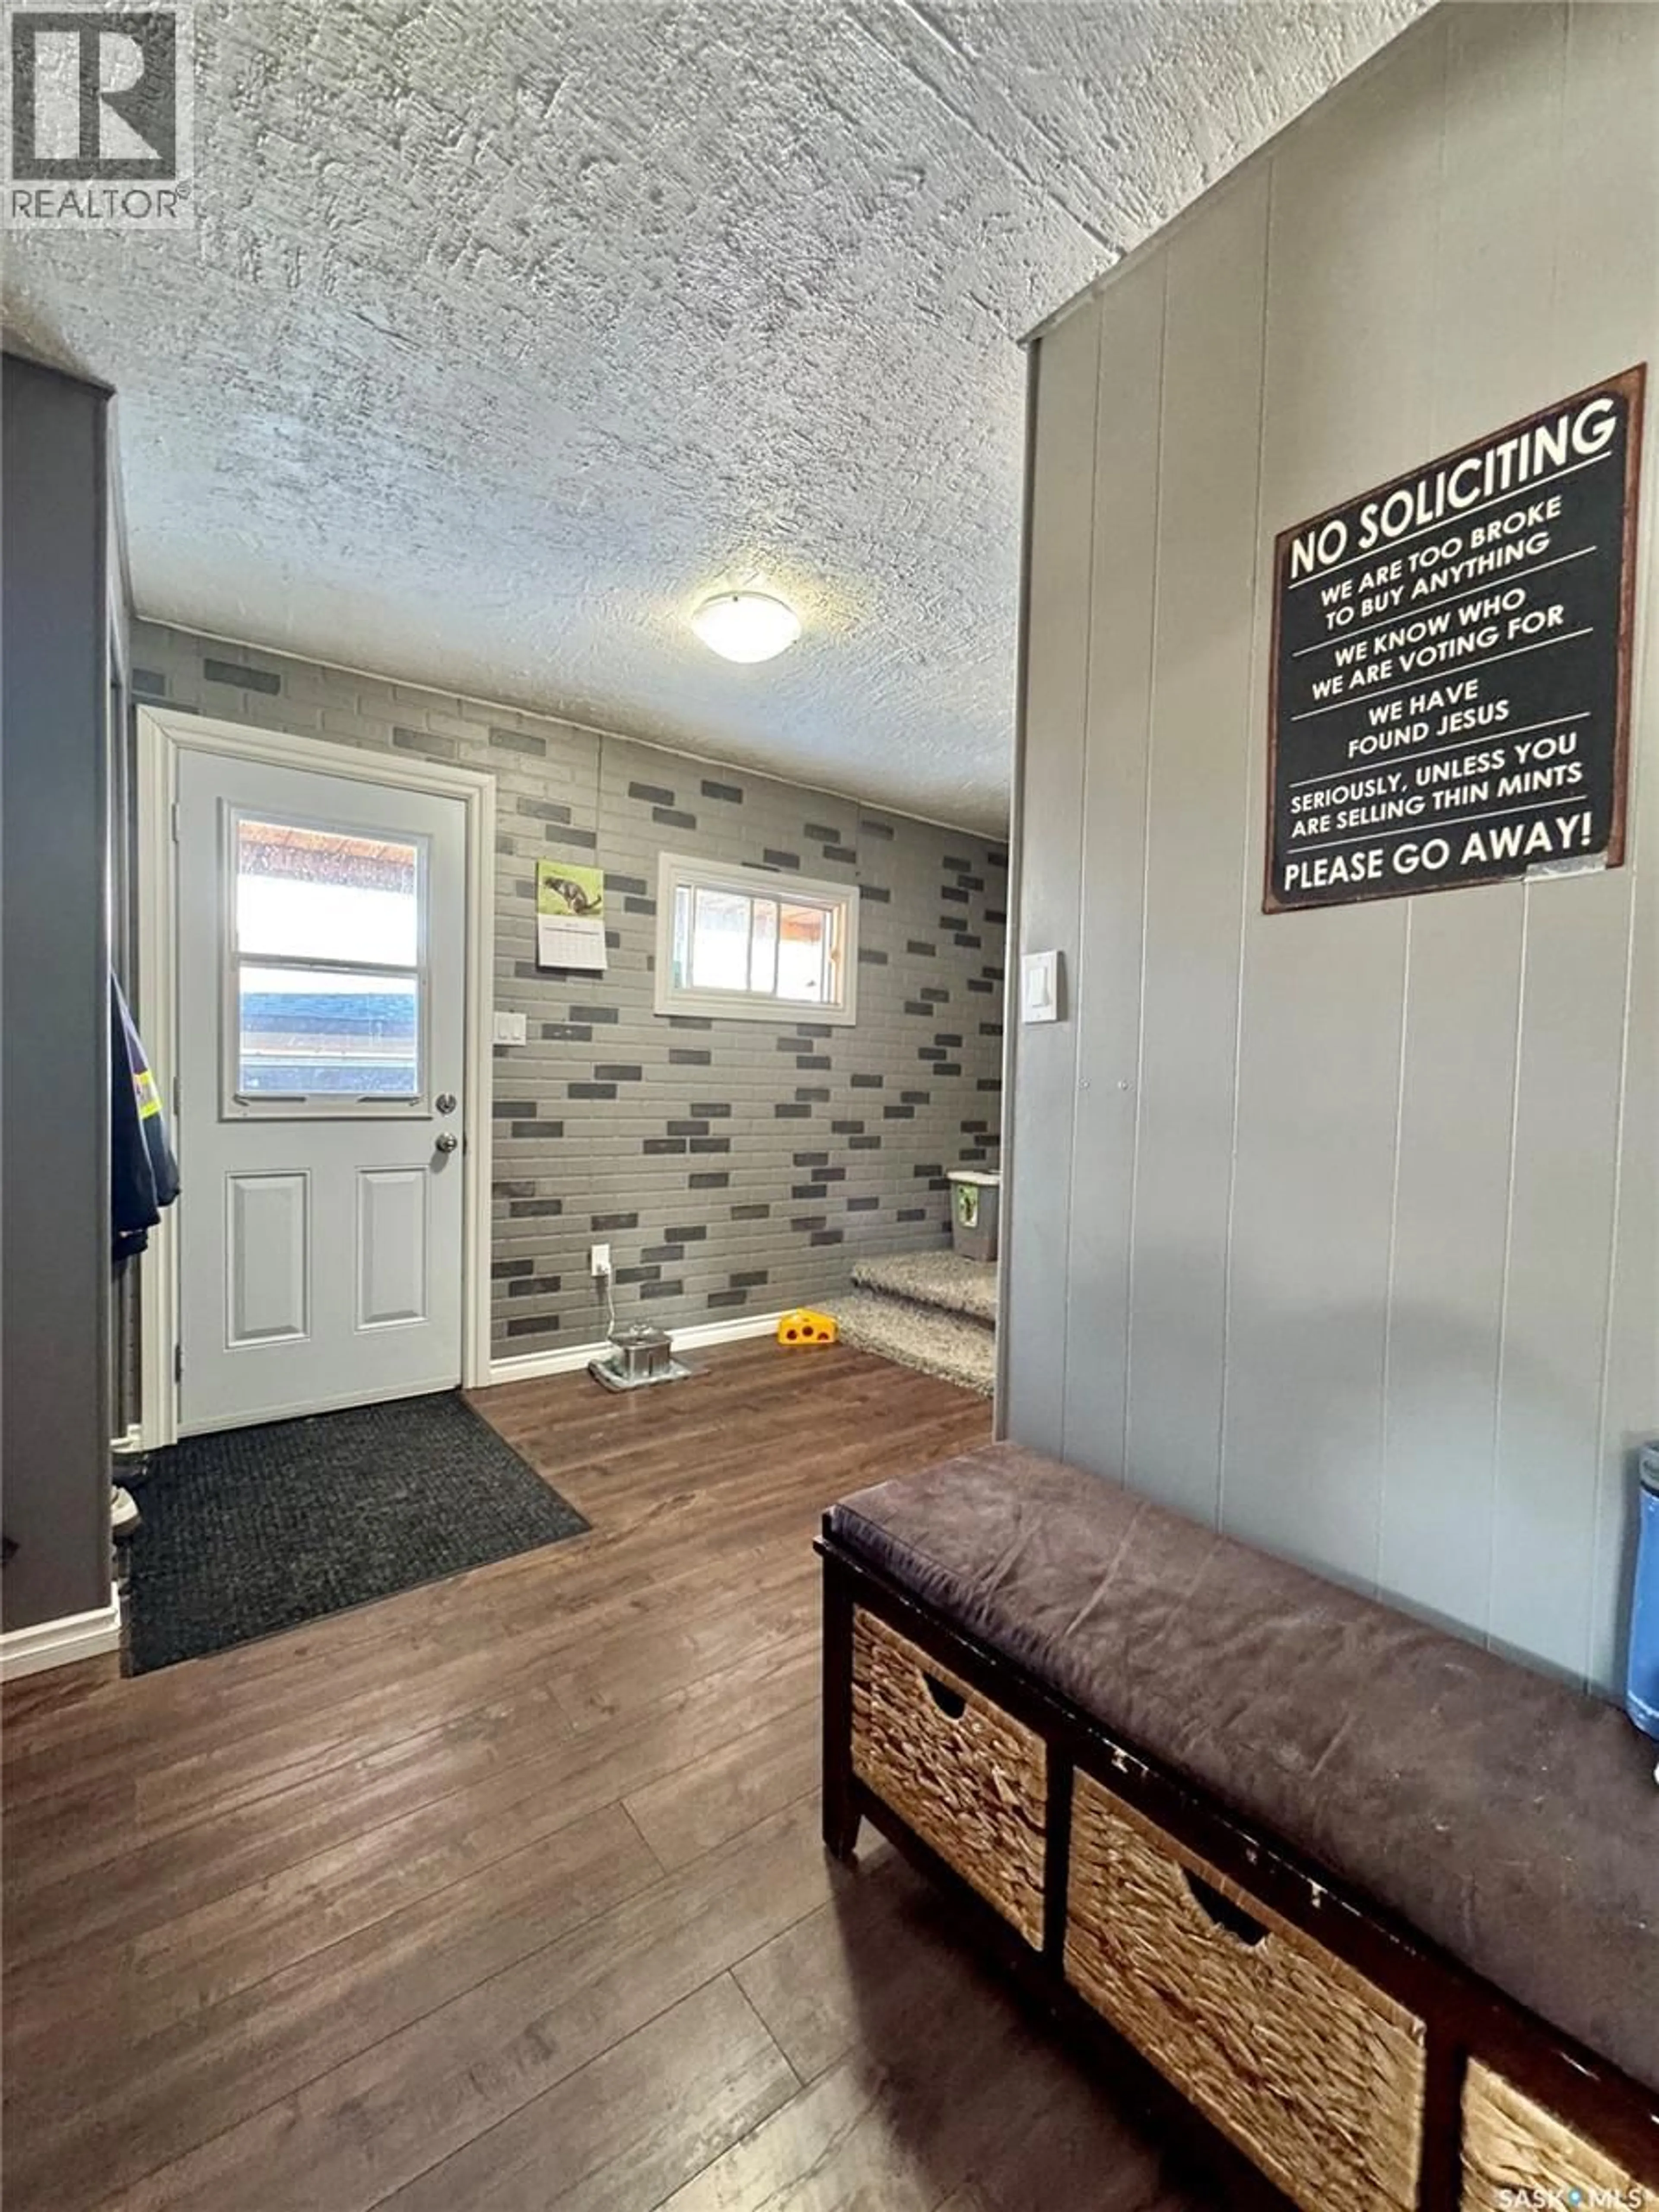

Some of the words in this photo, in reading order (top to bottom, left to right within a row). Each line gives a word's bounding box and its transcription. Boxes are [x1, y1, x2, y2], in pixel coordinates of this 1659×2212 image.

[1290, 519, 1348, 579] NO
[1358, 397, 1617, 549] SOLICITING
[1321, 579, 1353, 607] WE
[1357, 559, 1402, 594] ARE
[1408, 537, 1463, 573] TOO
[1470, 495, 1562, 549] BROKE
[1325, 606, 1355, 630] TO
[1360, 585, 1405, 618] BUY
[1411, 531, 1551, 600] ANYTHING
[1312, 674, 1344, 700] WE
[1348, 659, 1393, 690] ARE
[1398, 626, 1500, 672] VOTING
[1507, 604, 1564, 640] FOR
[1335, 640, 1368, 667] WE
[1373, 612, 1451, 655] KNOW
[1458, 588, 1526, 626] WHO
[1348, 721, 1430, 759] FOUND
[1436, 699, 1510, 736] JESUS
[1368, 700, 1403, 726] WE
[1409, 678, 1478, 716] HAVE
[1290, 772, 1408, 814] SERIOUSLY,
[1415, 748, 1506, 787] UNLESS
[1514, 731, 1577, 764] YOU
[1290, 814, 1331, 839] ARE
[1336, 795, 1426, 830] SELLING
[1431, 781, 1489, 810] THIN
[1496, 761, 1583, 798] MINTS
[1284, 848, 1384, 891] PLEASE
[1392, 838, 1450, 874] GO
[1460, 811, 1592, 865] AWAY!
